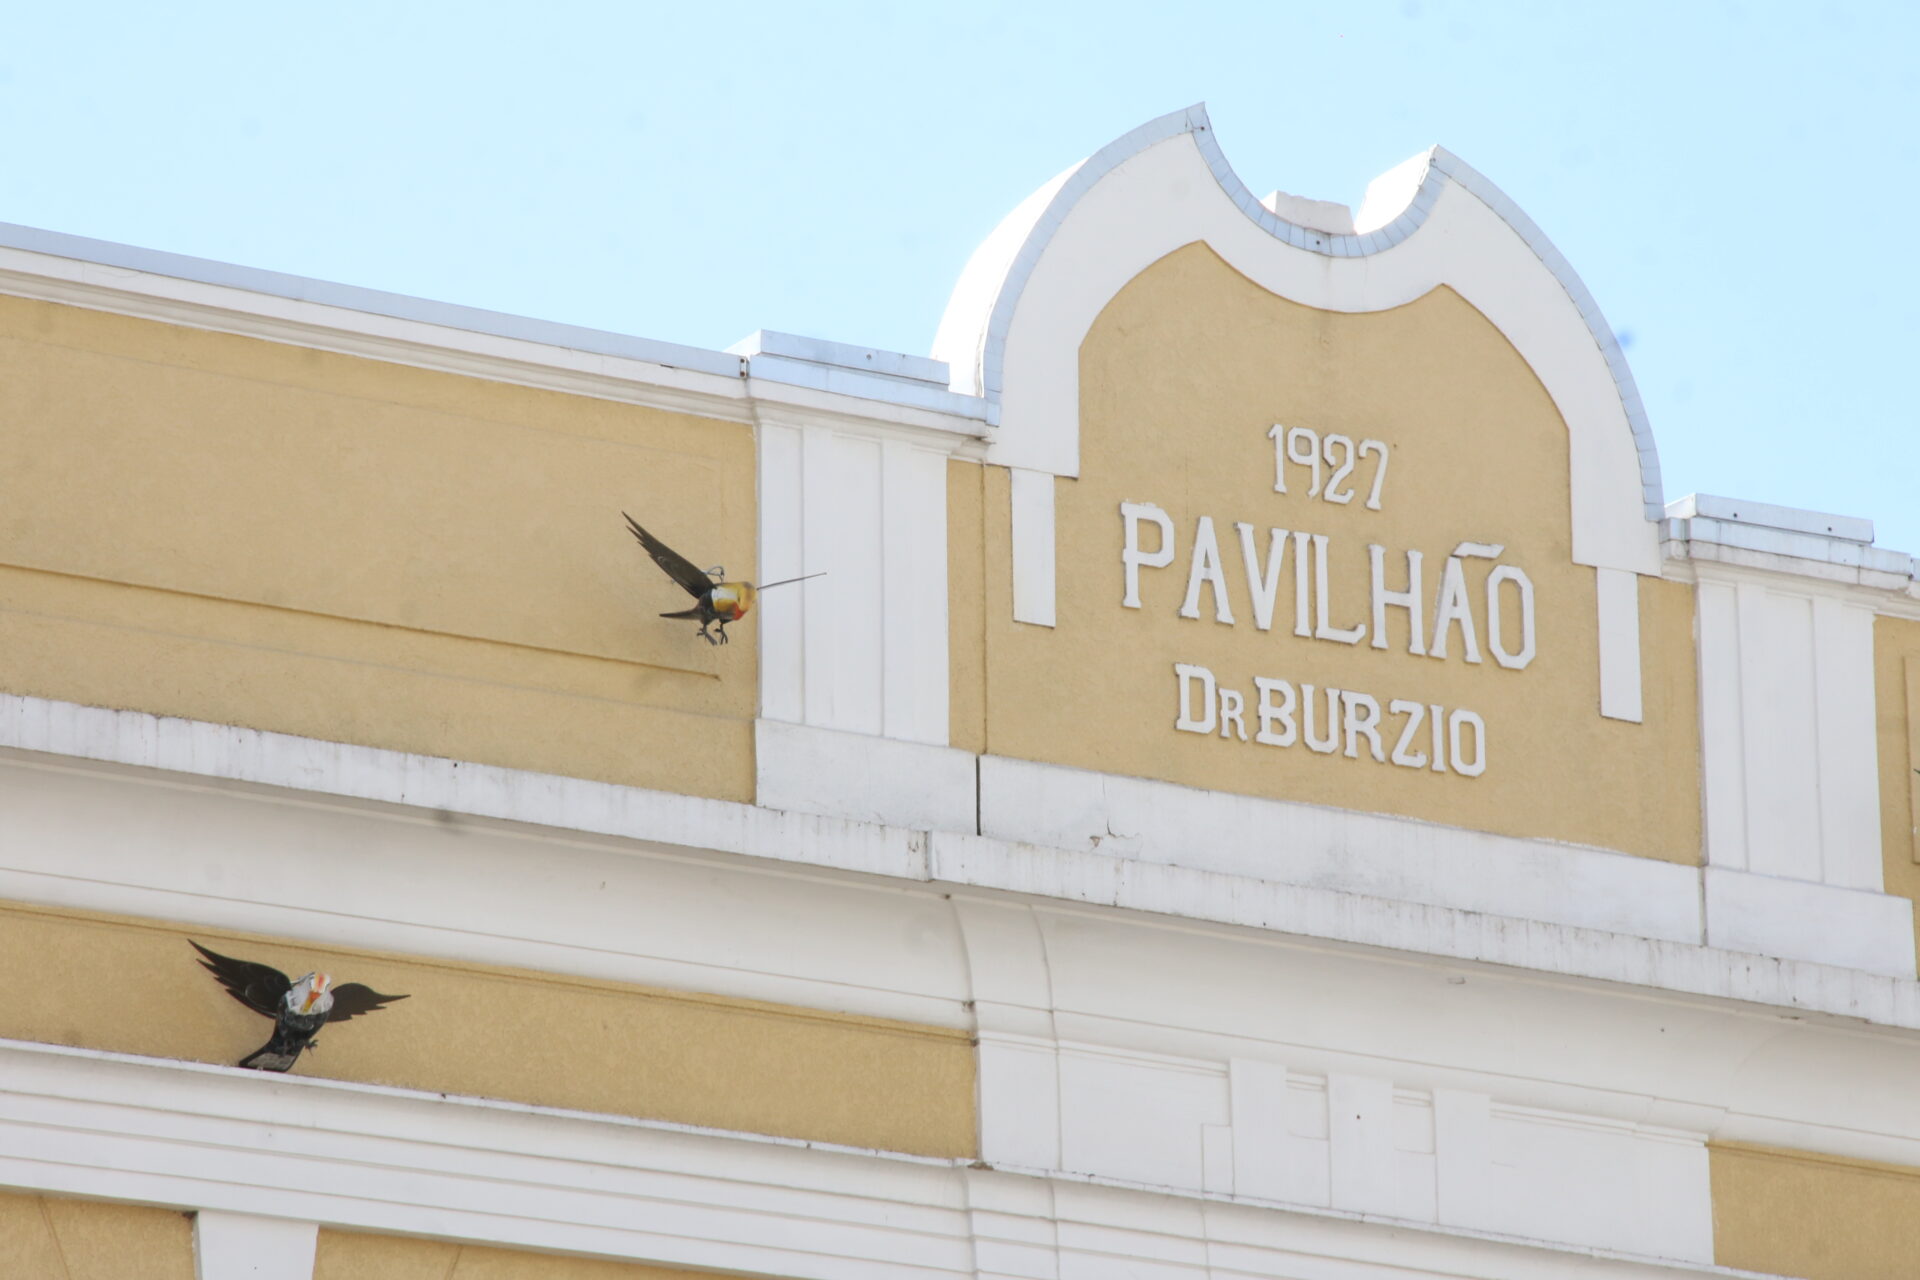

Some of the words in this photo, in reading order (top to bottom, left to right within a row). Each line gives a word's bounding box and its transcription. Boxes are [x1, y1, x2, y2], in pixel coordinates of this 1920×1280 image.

[1268, 424, 1389, 510] 1927
[1120, 501, 1536, 670] PAVILHÃO
[1254, 676, 1486, 777] BURZIO
